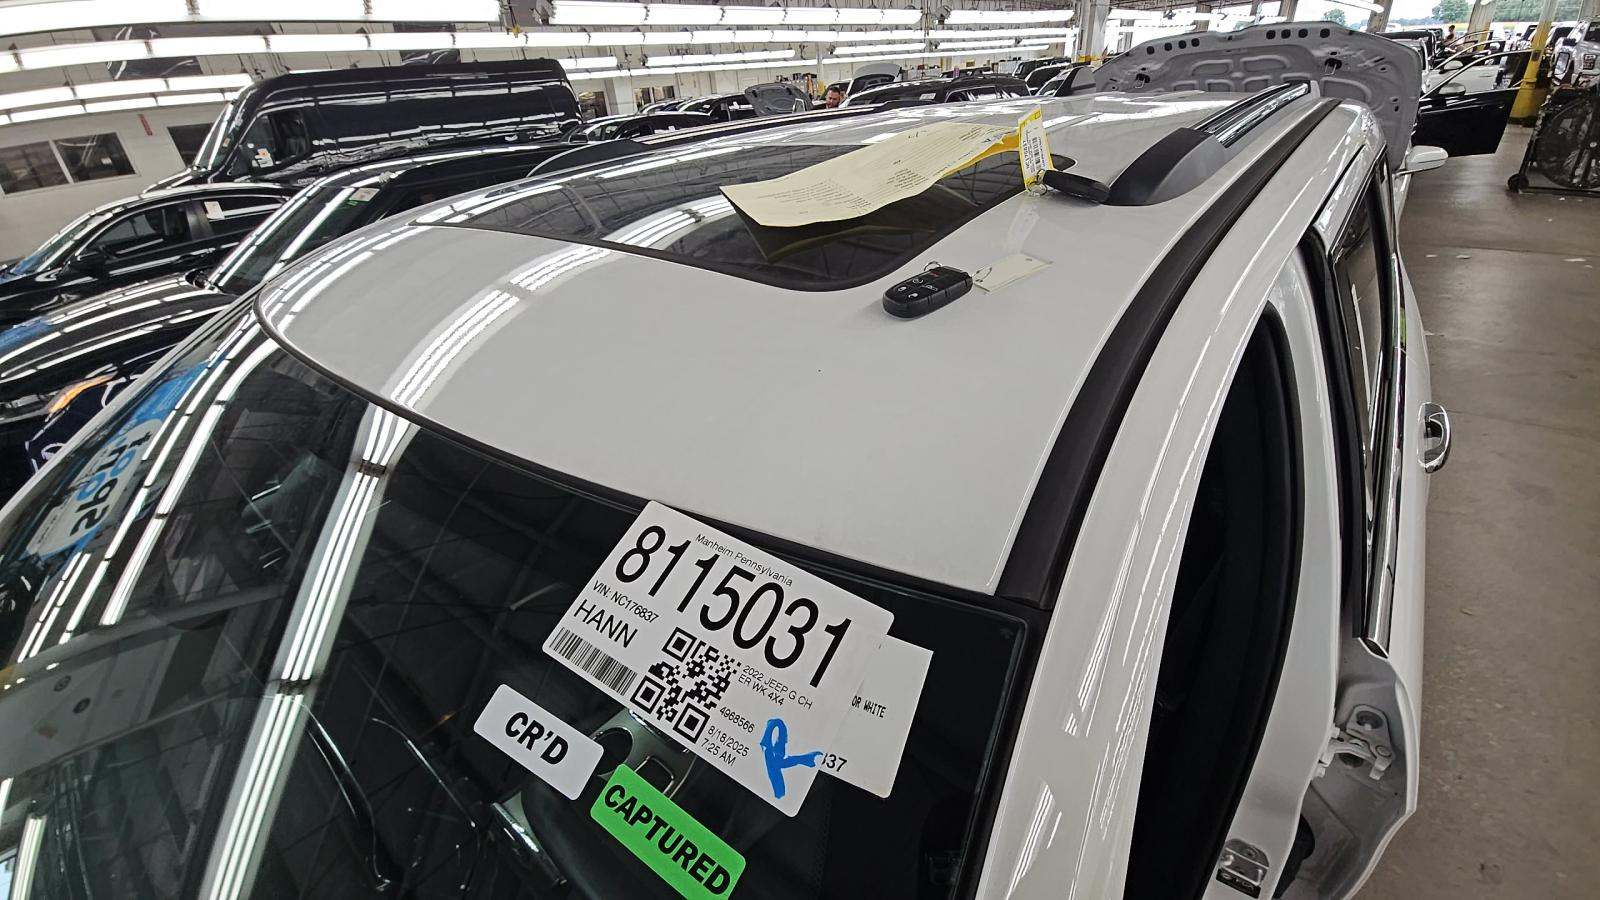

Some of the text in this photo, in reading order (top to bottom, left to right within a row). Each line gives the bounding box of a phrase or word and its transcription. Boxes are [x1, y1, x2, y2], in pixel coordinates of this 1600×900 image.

[695, 533, 793, 587] Manheim Pennsylvania
[573, 599, 638, 648] HANN
[592, 580, 660, 623] VIN: NC176837
[615, 525, 852, 688] 8115031
[738, 673, 785, 706] ER WK 4X4
[743, 665, 813, 710] 2022 JEEP G CH
[863, 699, 887, 719] WHITE
[505, 712, 569, 765] CR'D
[707, 725, 751, 758] 8/18/2025
[719, 706, 756, 734] 4968566
[700, 738, 737, 767] 7:25 AM
[604, 784, 731, 896] CAPTURED
